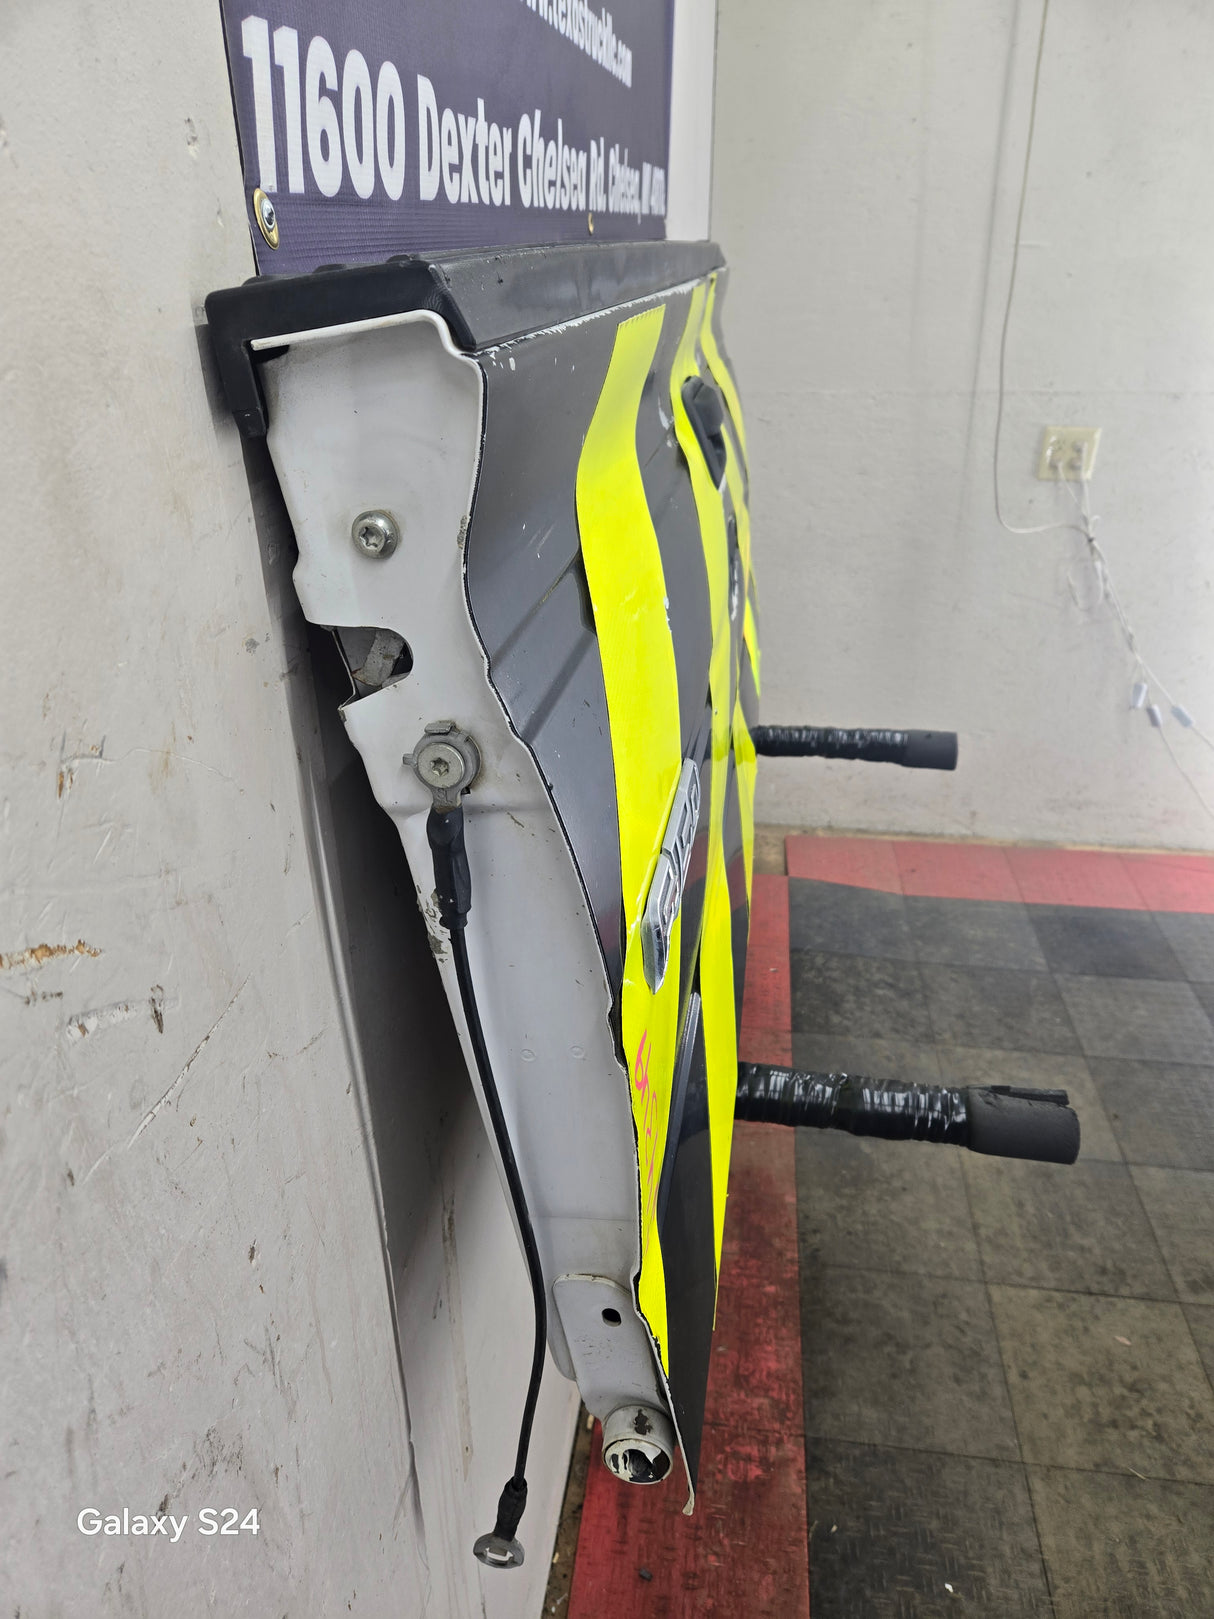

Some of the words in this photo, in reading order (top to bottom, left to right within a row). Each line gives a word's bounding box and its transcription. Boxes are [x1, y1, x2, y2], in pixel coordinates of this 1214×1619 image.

[241, 14, 406, 201] 11600
[417, 74, 512, 206] Dexter
[517, 109, 587, 211] Chelsea
[589, 137, 606, 212] Rd.
